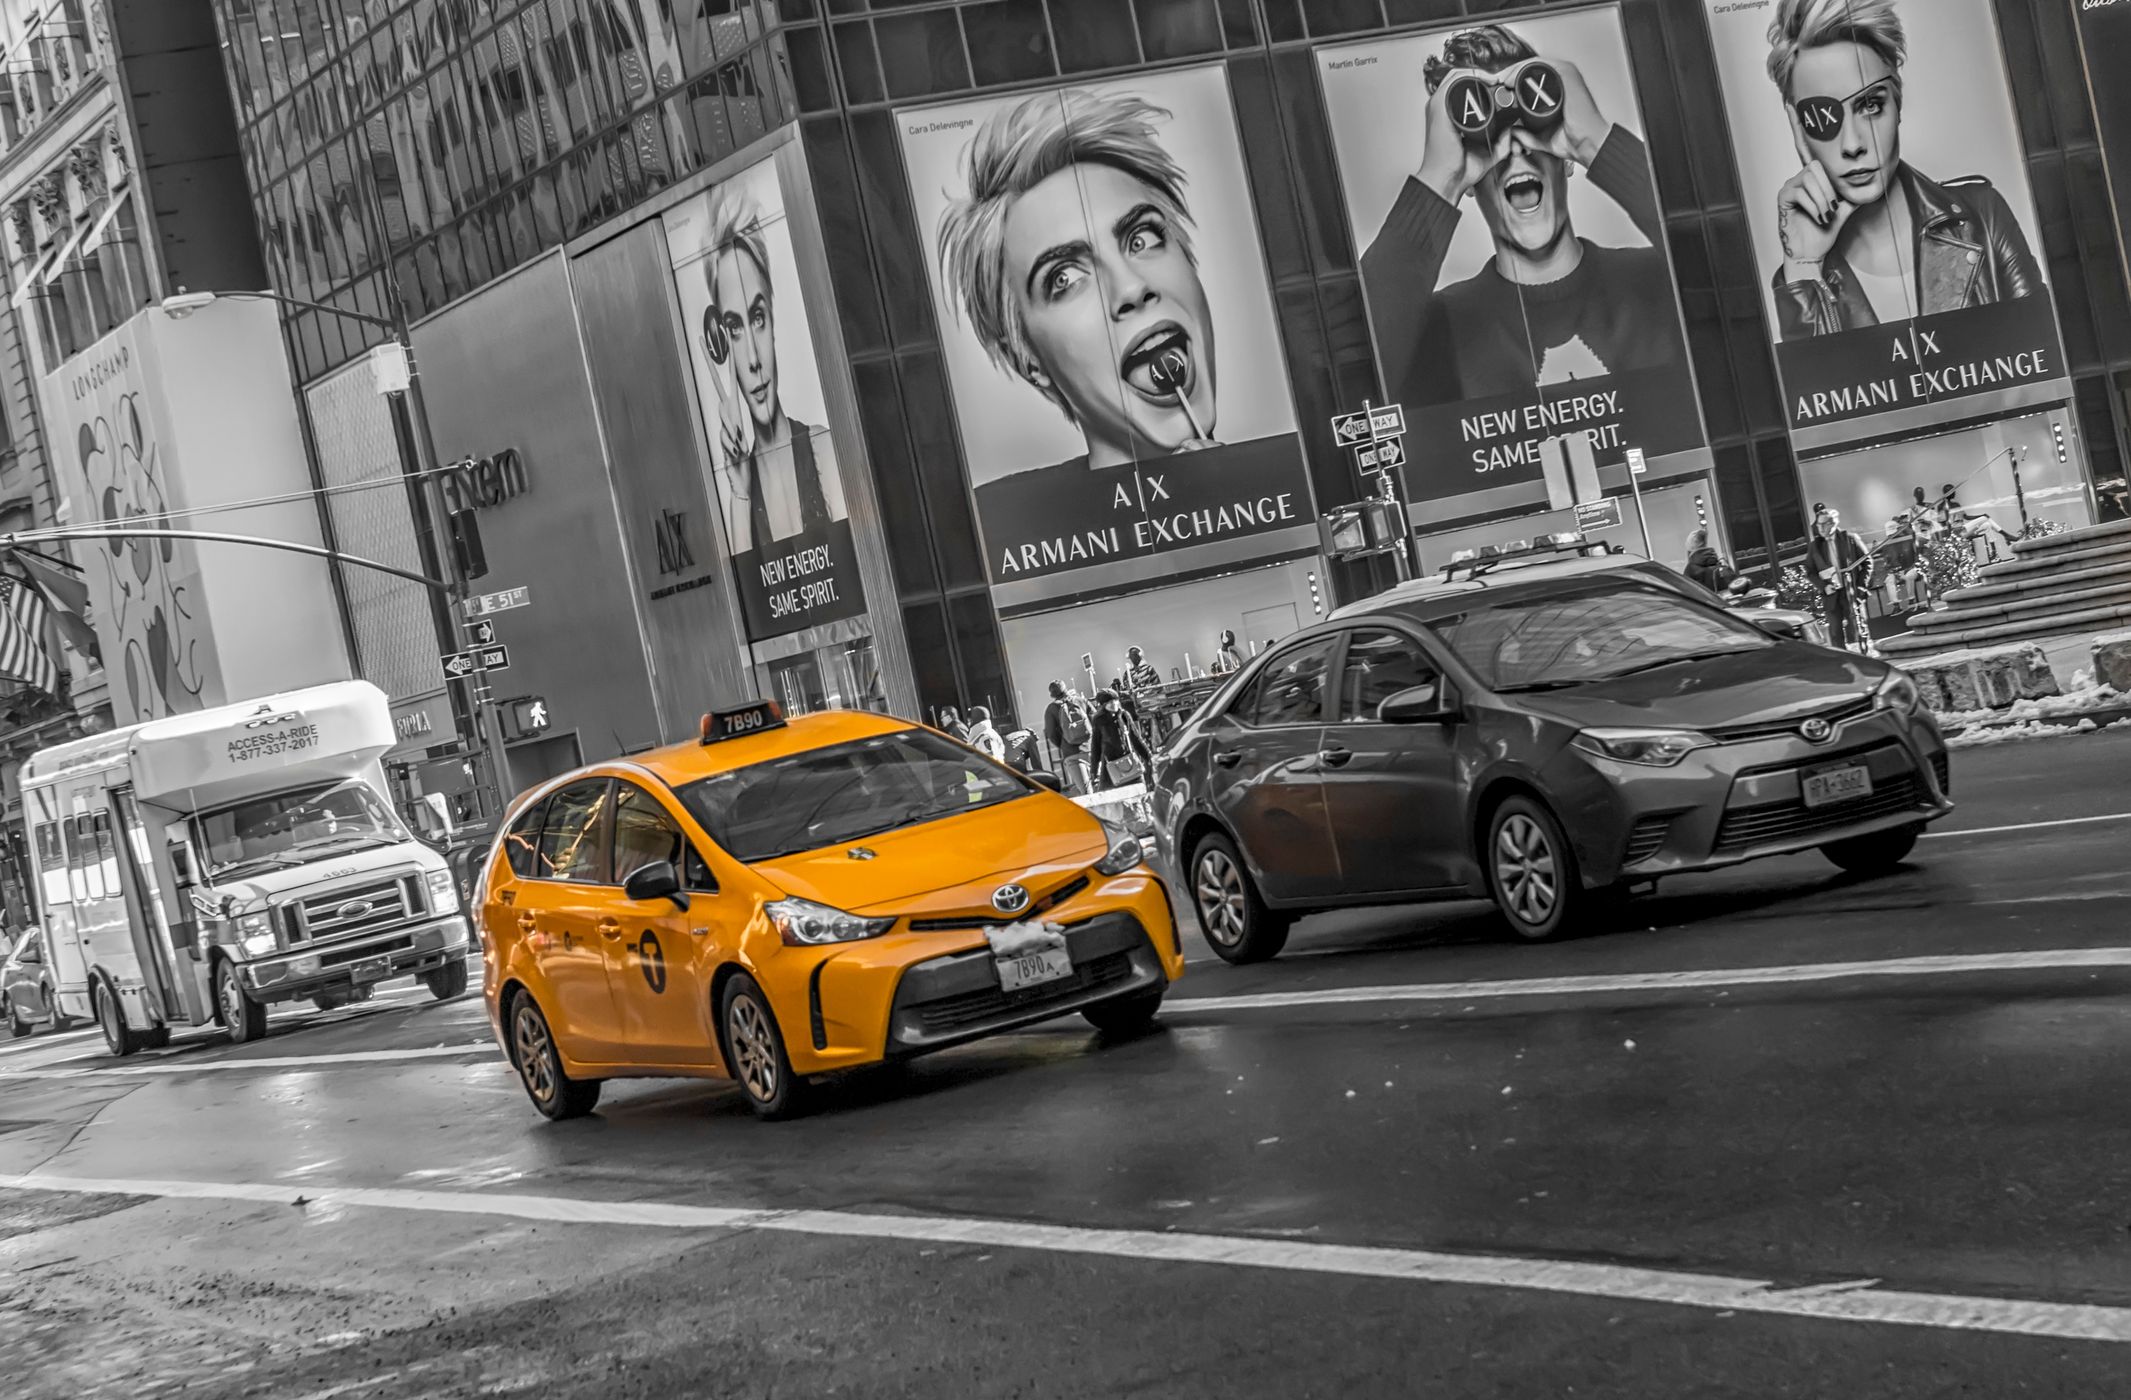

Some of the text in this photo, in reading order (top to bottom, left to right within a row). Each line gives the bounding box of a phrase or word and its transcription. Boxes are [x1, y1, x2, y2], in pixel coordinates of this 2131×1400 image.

[1328, 60, 1354, 70] Martin
[908, 118, 974, 135] Cara Delevingne
[1796, 349, 2049, 431] ARMANI EXCHANGE
[1345, 415, 1393, 435] ONE WAY
[1460, 390, 1625, 442] NEW ENERGY.
[1472, 438, 1541, 473] SAME
[1001, 493, 1297, 575] ARMANI EXCHANGE
[759, 543, 834, 588] NEW ENERGY.
[486, 596, 496, 611] E
[769, 577, 840, 619] SAME SPIRIT.
[452, 660, 472, 671] ONE
[396, 710, 432, 739] FURLA
[723, 710, 763, 734] 7B90
[226, 723, 318, 753] ACCESS-A-RIDE
[228, 735, 320, 764] 1-877-337-2017
